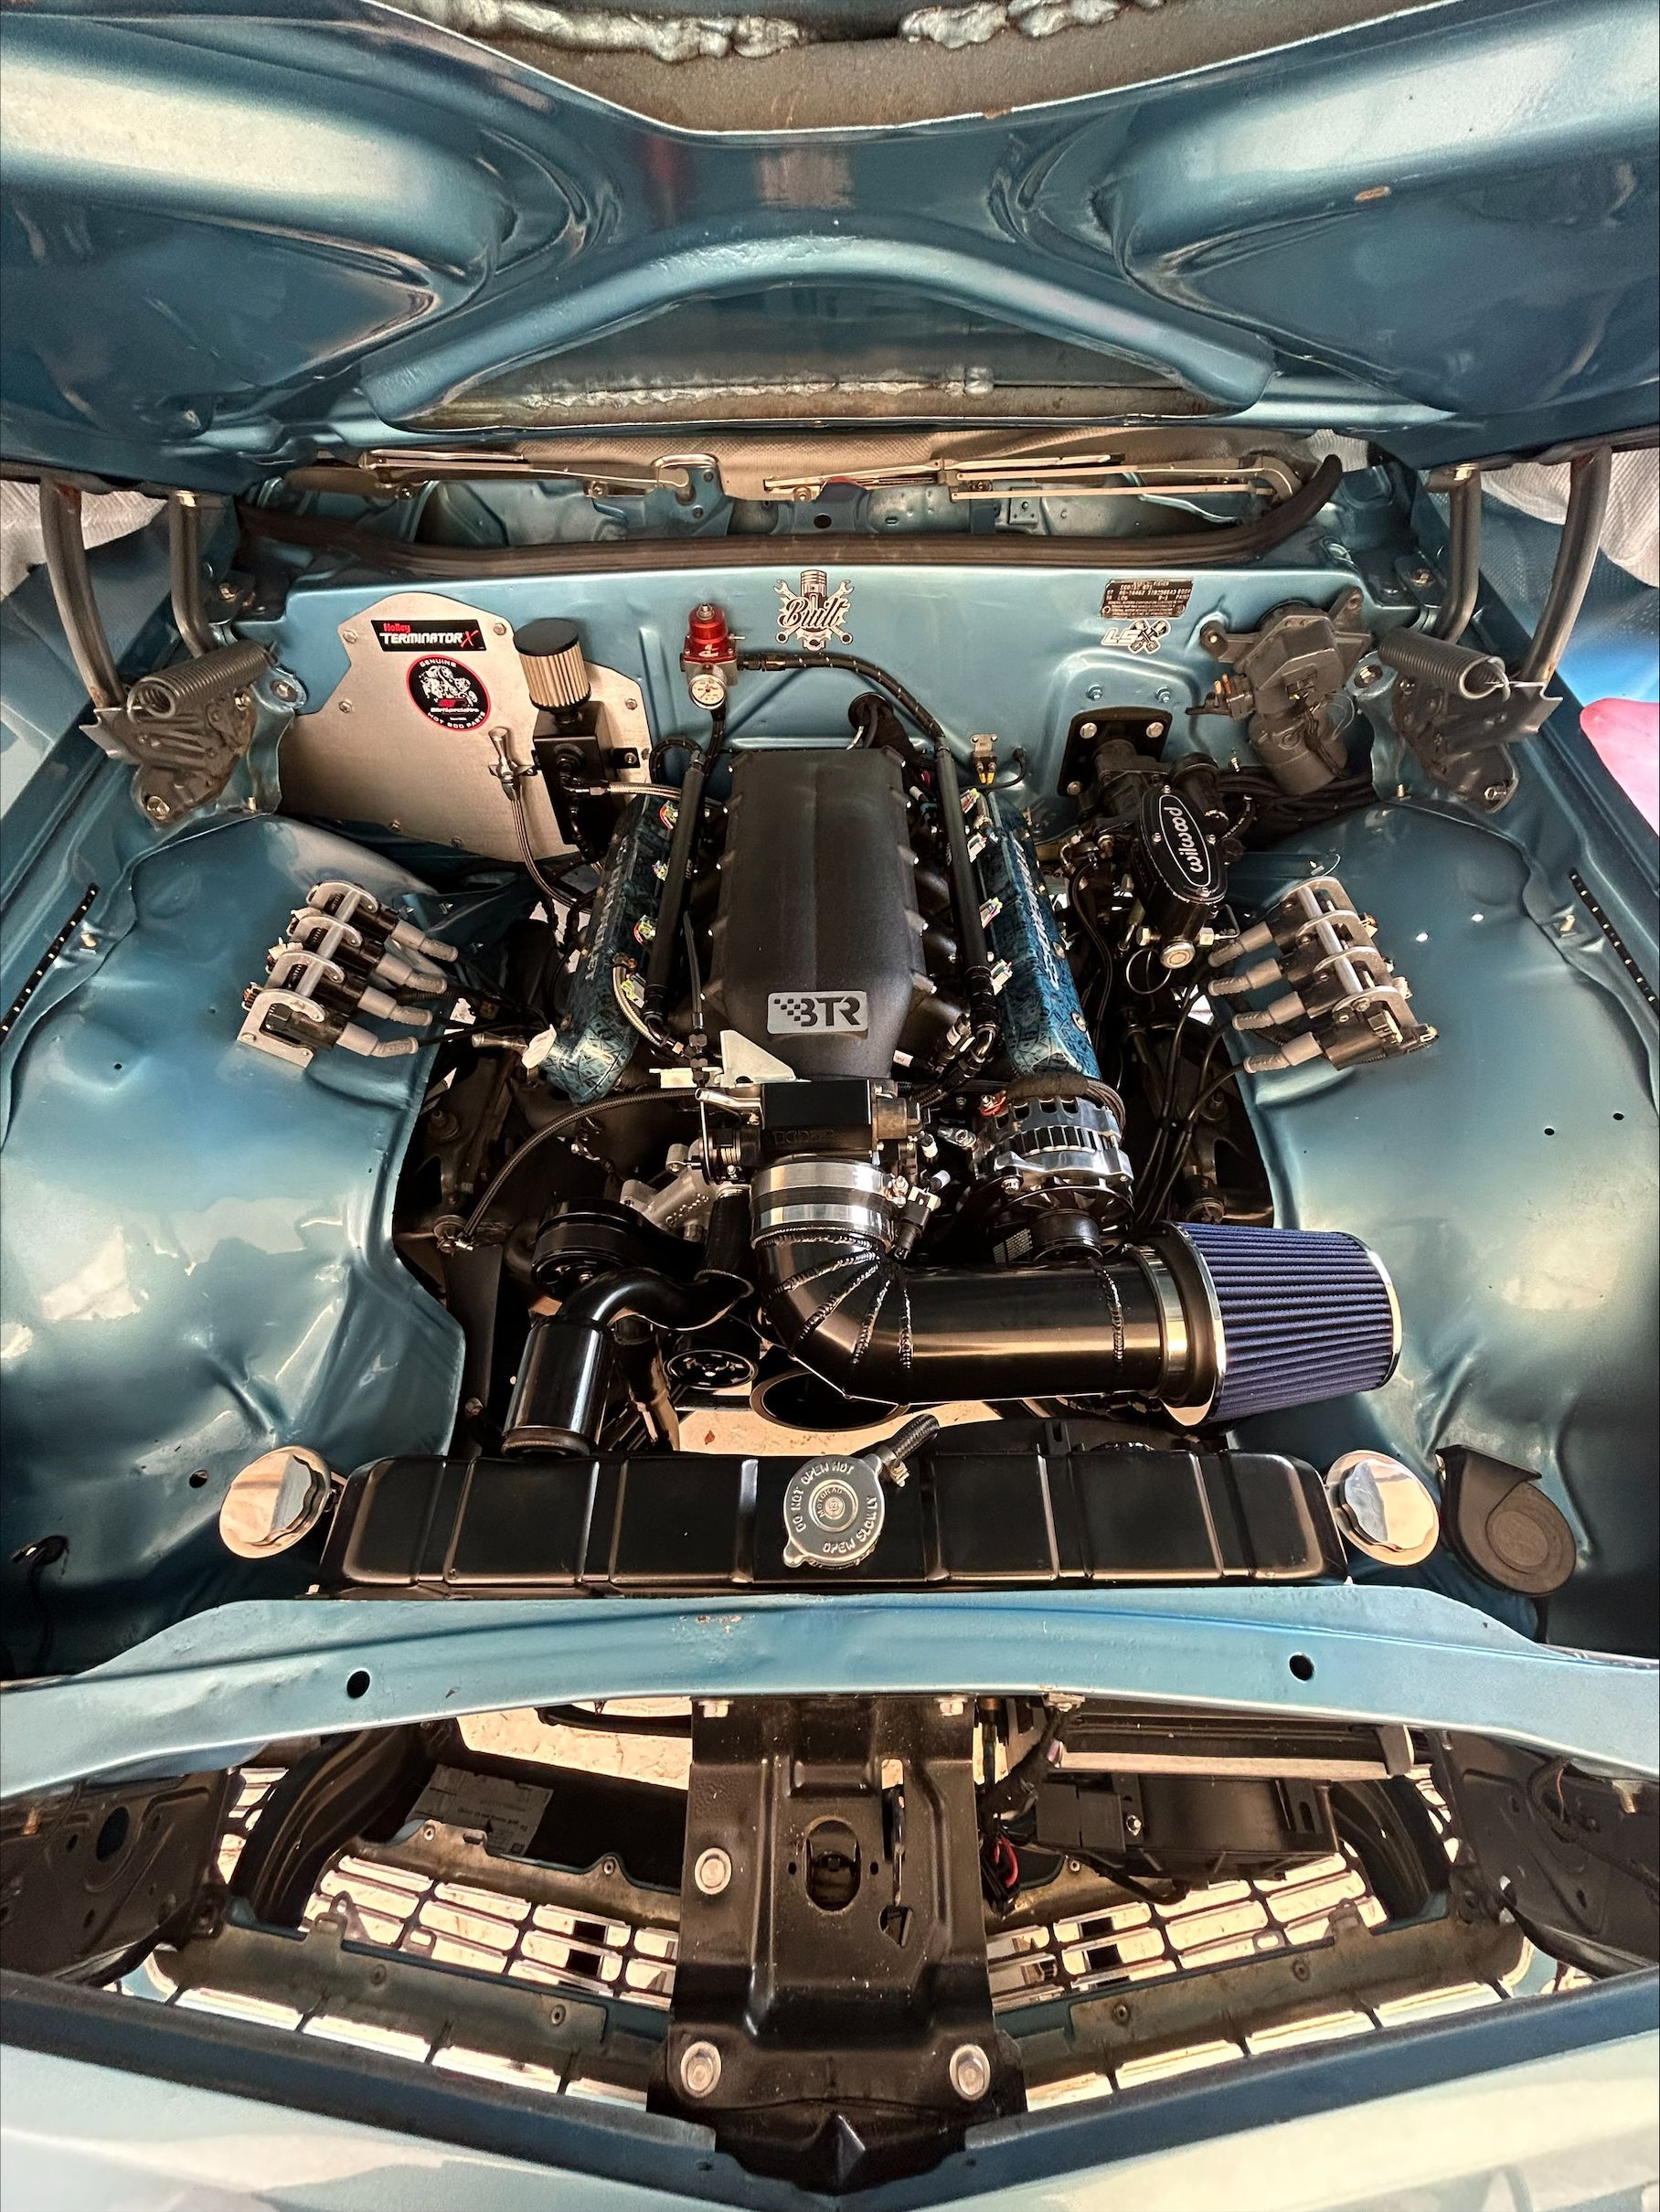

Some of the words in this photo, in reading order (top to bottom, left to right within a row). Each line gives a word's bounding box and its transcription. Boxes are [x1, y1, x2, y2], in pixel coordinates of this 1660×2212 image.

[778, 596, 848, 628] Built
[383, 623, 410, 633] Holley
[420, 659, 456, 668] GENUINE
[427, 712, 445, 725] HOT
[466, 711, 486, 728] PARTS
[1163, 806, 1205, 873] wilwood
[797, 996, 861, 1027] BTR
[801, 1462, 829, 1485] OPEN
[832, 1462, 855, 1474] HOT
[791, 1486, 803, 1511] NOT
[817, 1487, 843, 1518] MOTORAD
[793, 1515, 806, 1533] DO
[823, 1538, 856, 1554] OPEN
[857, 1496, 878, 1542] SLOWLY
